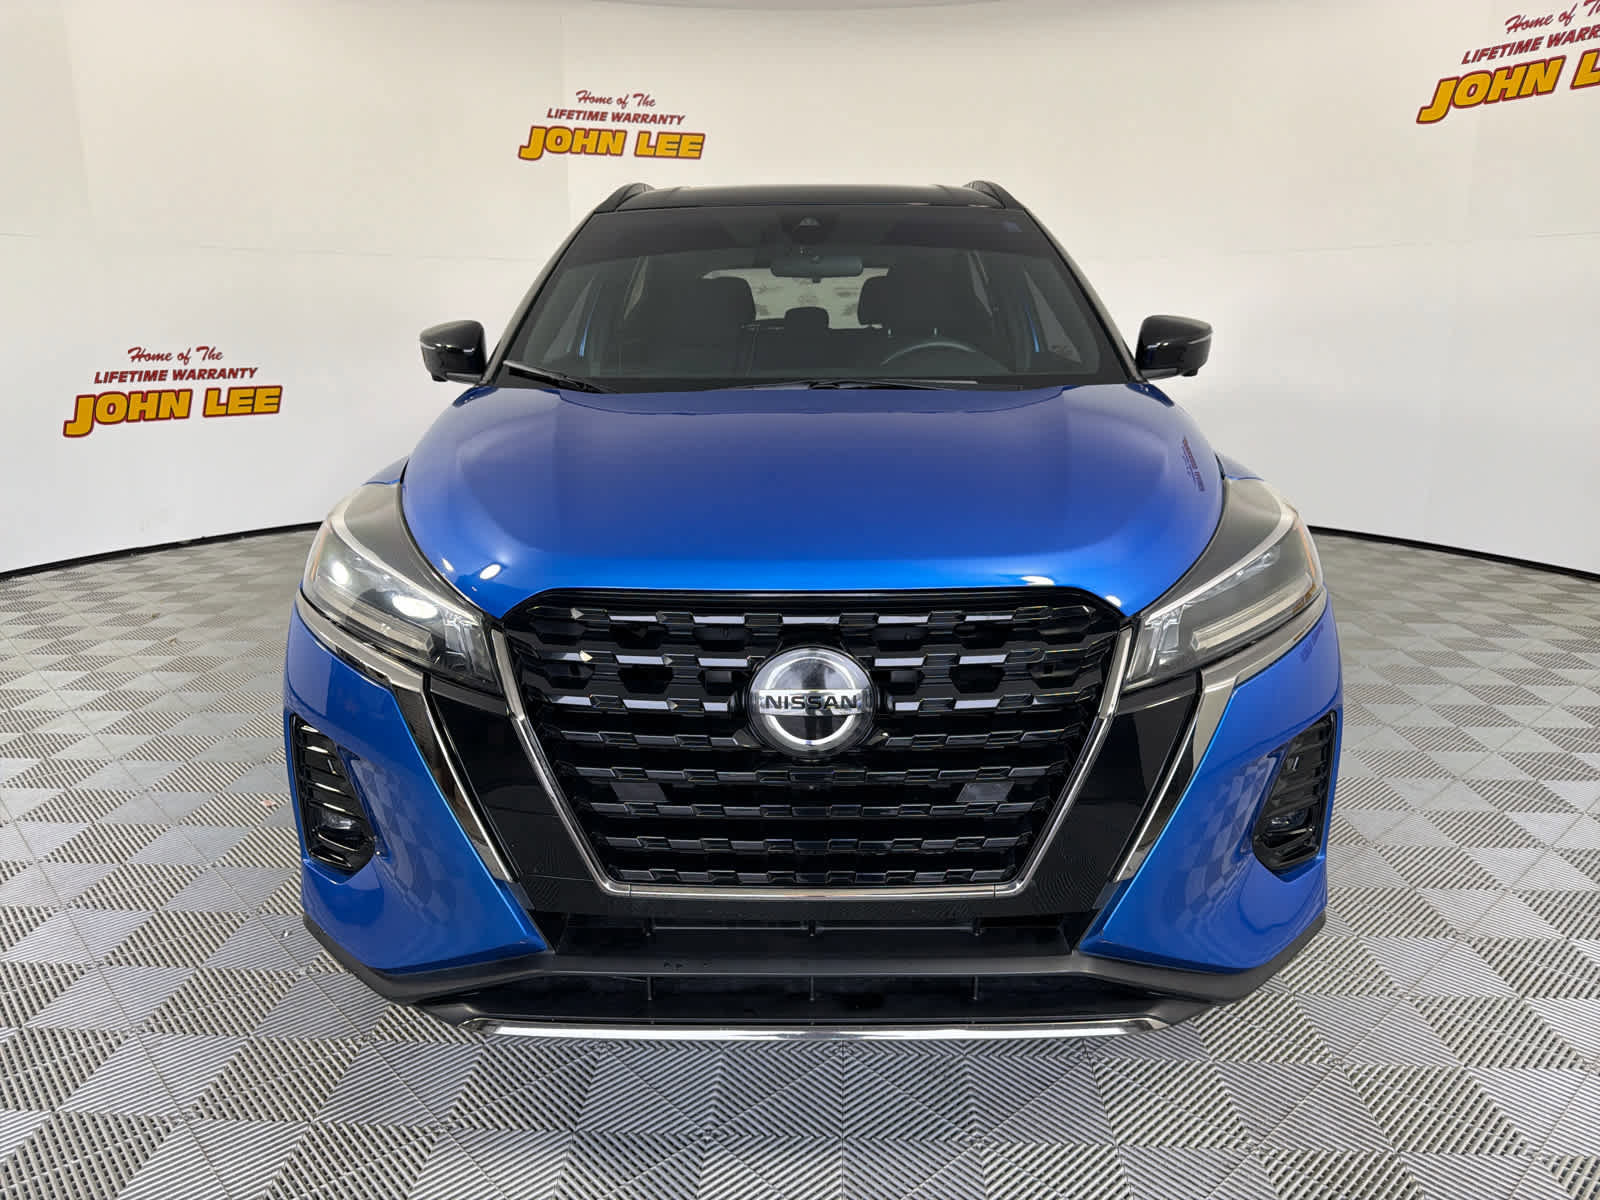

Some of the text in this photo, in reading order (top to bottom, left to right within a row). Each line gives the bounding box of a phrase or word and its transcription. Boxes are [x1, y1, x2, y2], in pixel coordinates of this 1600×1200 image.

[1505, 14, 1553, 34] Home
[1558, 4, 1577, 26] of
[1461, 36, 1544, 64] LIFETIME
[576, 90, 656, 108] Home of The
[1416, 55, 1566, 124] JOHN
[547, 108, 686, 125] LIFETIME WARRANTY
[518, 126, 705, 160] JOHN LEE
[128, 346, 223, 365] Home of The
[94, 367, 258, 384] LIFETIME WARRANTY
[63, 385, 283, 438] JOHN LEE
[765, 695, 857, 709] NISSAN
